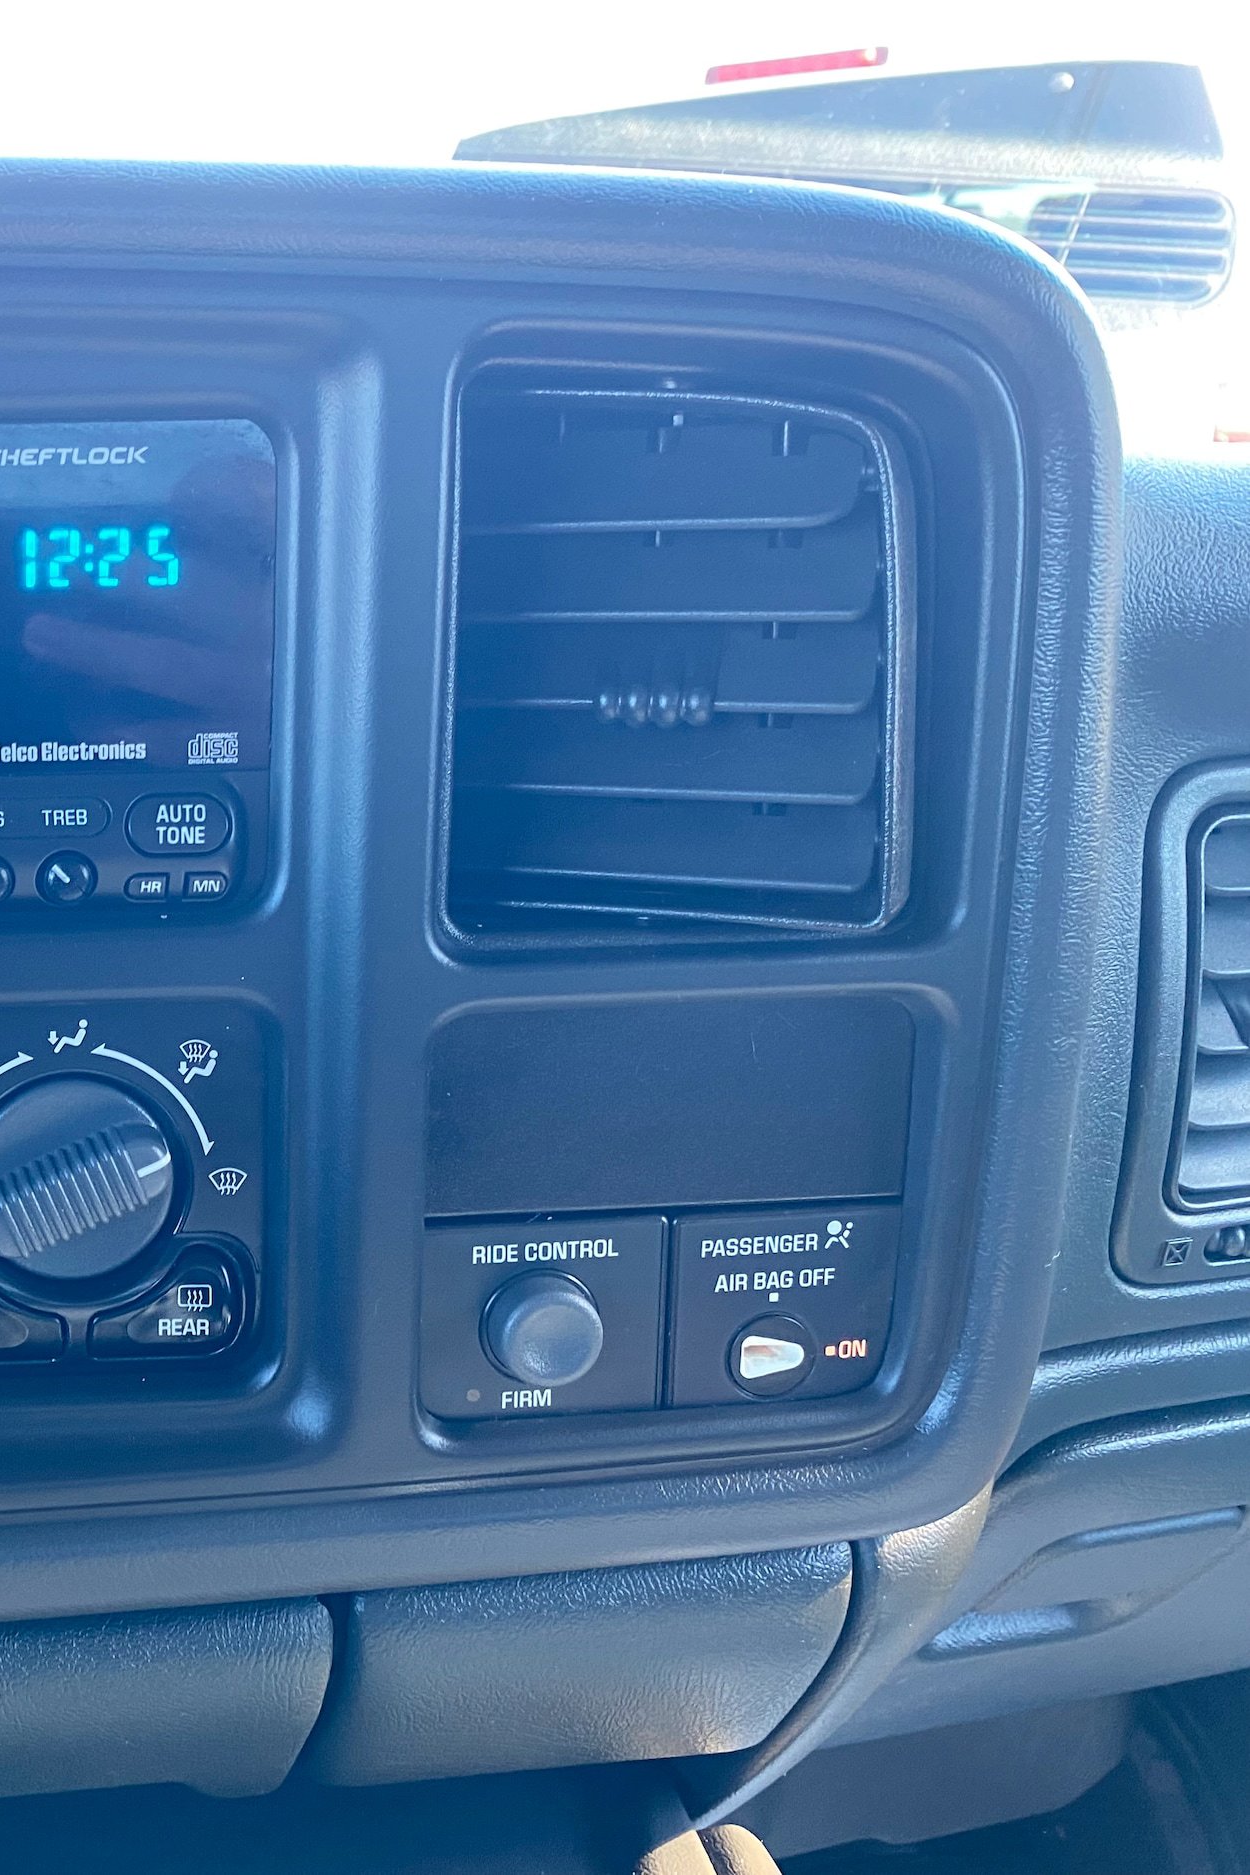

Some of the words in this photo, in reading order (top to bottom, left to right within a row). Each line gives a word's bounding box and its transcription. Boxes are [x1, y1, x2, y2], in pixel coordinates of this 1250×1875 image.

[20, 526, 181, 590] 12:25
[40, 740, 148, 763] Electronics
[41, 809, 88, 826] TREB
[156, 803, 206, 824] AUTO
[155, 825, 206, 845] TONE
[140, 880, 162, 893] HR
[193, 879, 221, 893] MN
[472, 1244, 519, 1265] RIDE
[524, 1238, 619, 1262] CONTROL
[701, 1233, 818, 1258] PASSENGER
[714, 1273, 748, 1293] AIR
[753, 1270, 794, 1291] BAG
[799, 1267, 836, 1287] OFF
[158, 1317, 210, 1336] REAR
[838, 1339, 867, 1359] ON
[501, 1388, 552, 1409] FIRM
